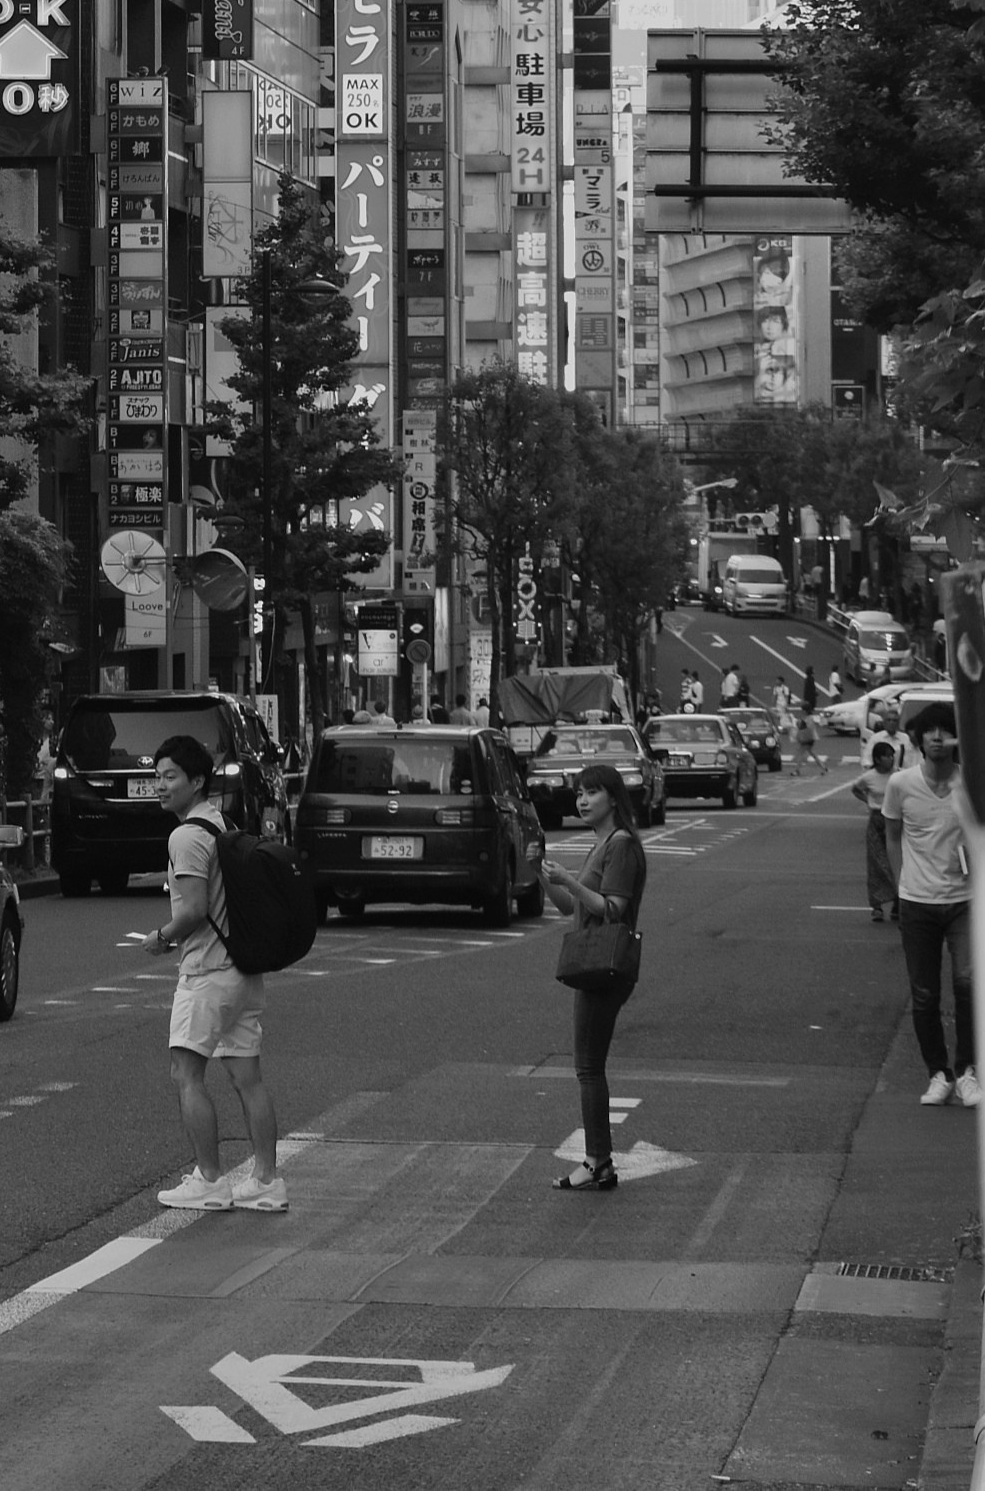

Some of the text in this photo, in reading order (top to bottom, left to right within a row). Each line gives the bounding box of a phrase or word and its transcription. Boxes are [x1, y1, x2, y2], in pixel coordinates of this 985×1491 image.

[231, 46, 245, 56] 4F
[346, 79, 379, 90] MAX
[515, 53, 545, 137] 駐車場
[122, 114, 160, 127] かもめ
[346, 112, 379, 129] OK
[119, 345, 160, 363] Janis
[121, 369, 163, 385] AJITO
[126, 404, 158, 419] ひまわり
[135, 486, 162, 503] 極楽
[110, 514, 161, 524] ナカヨシビル
